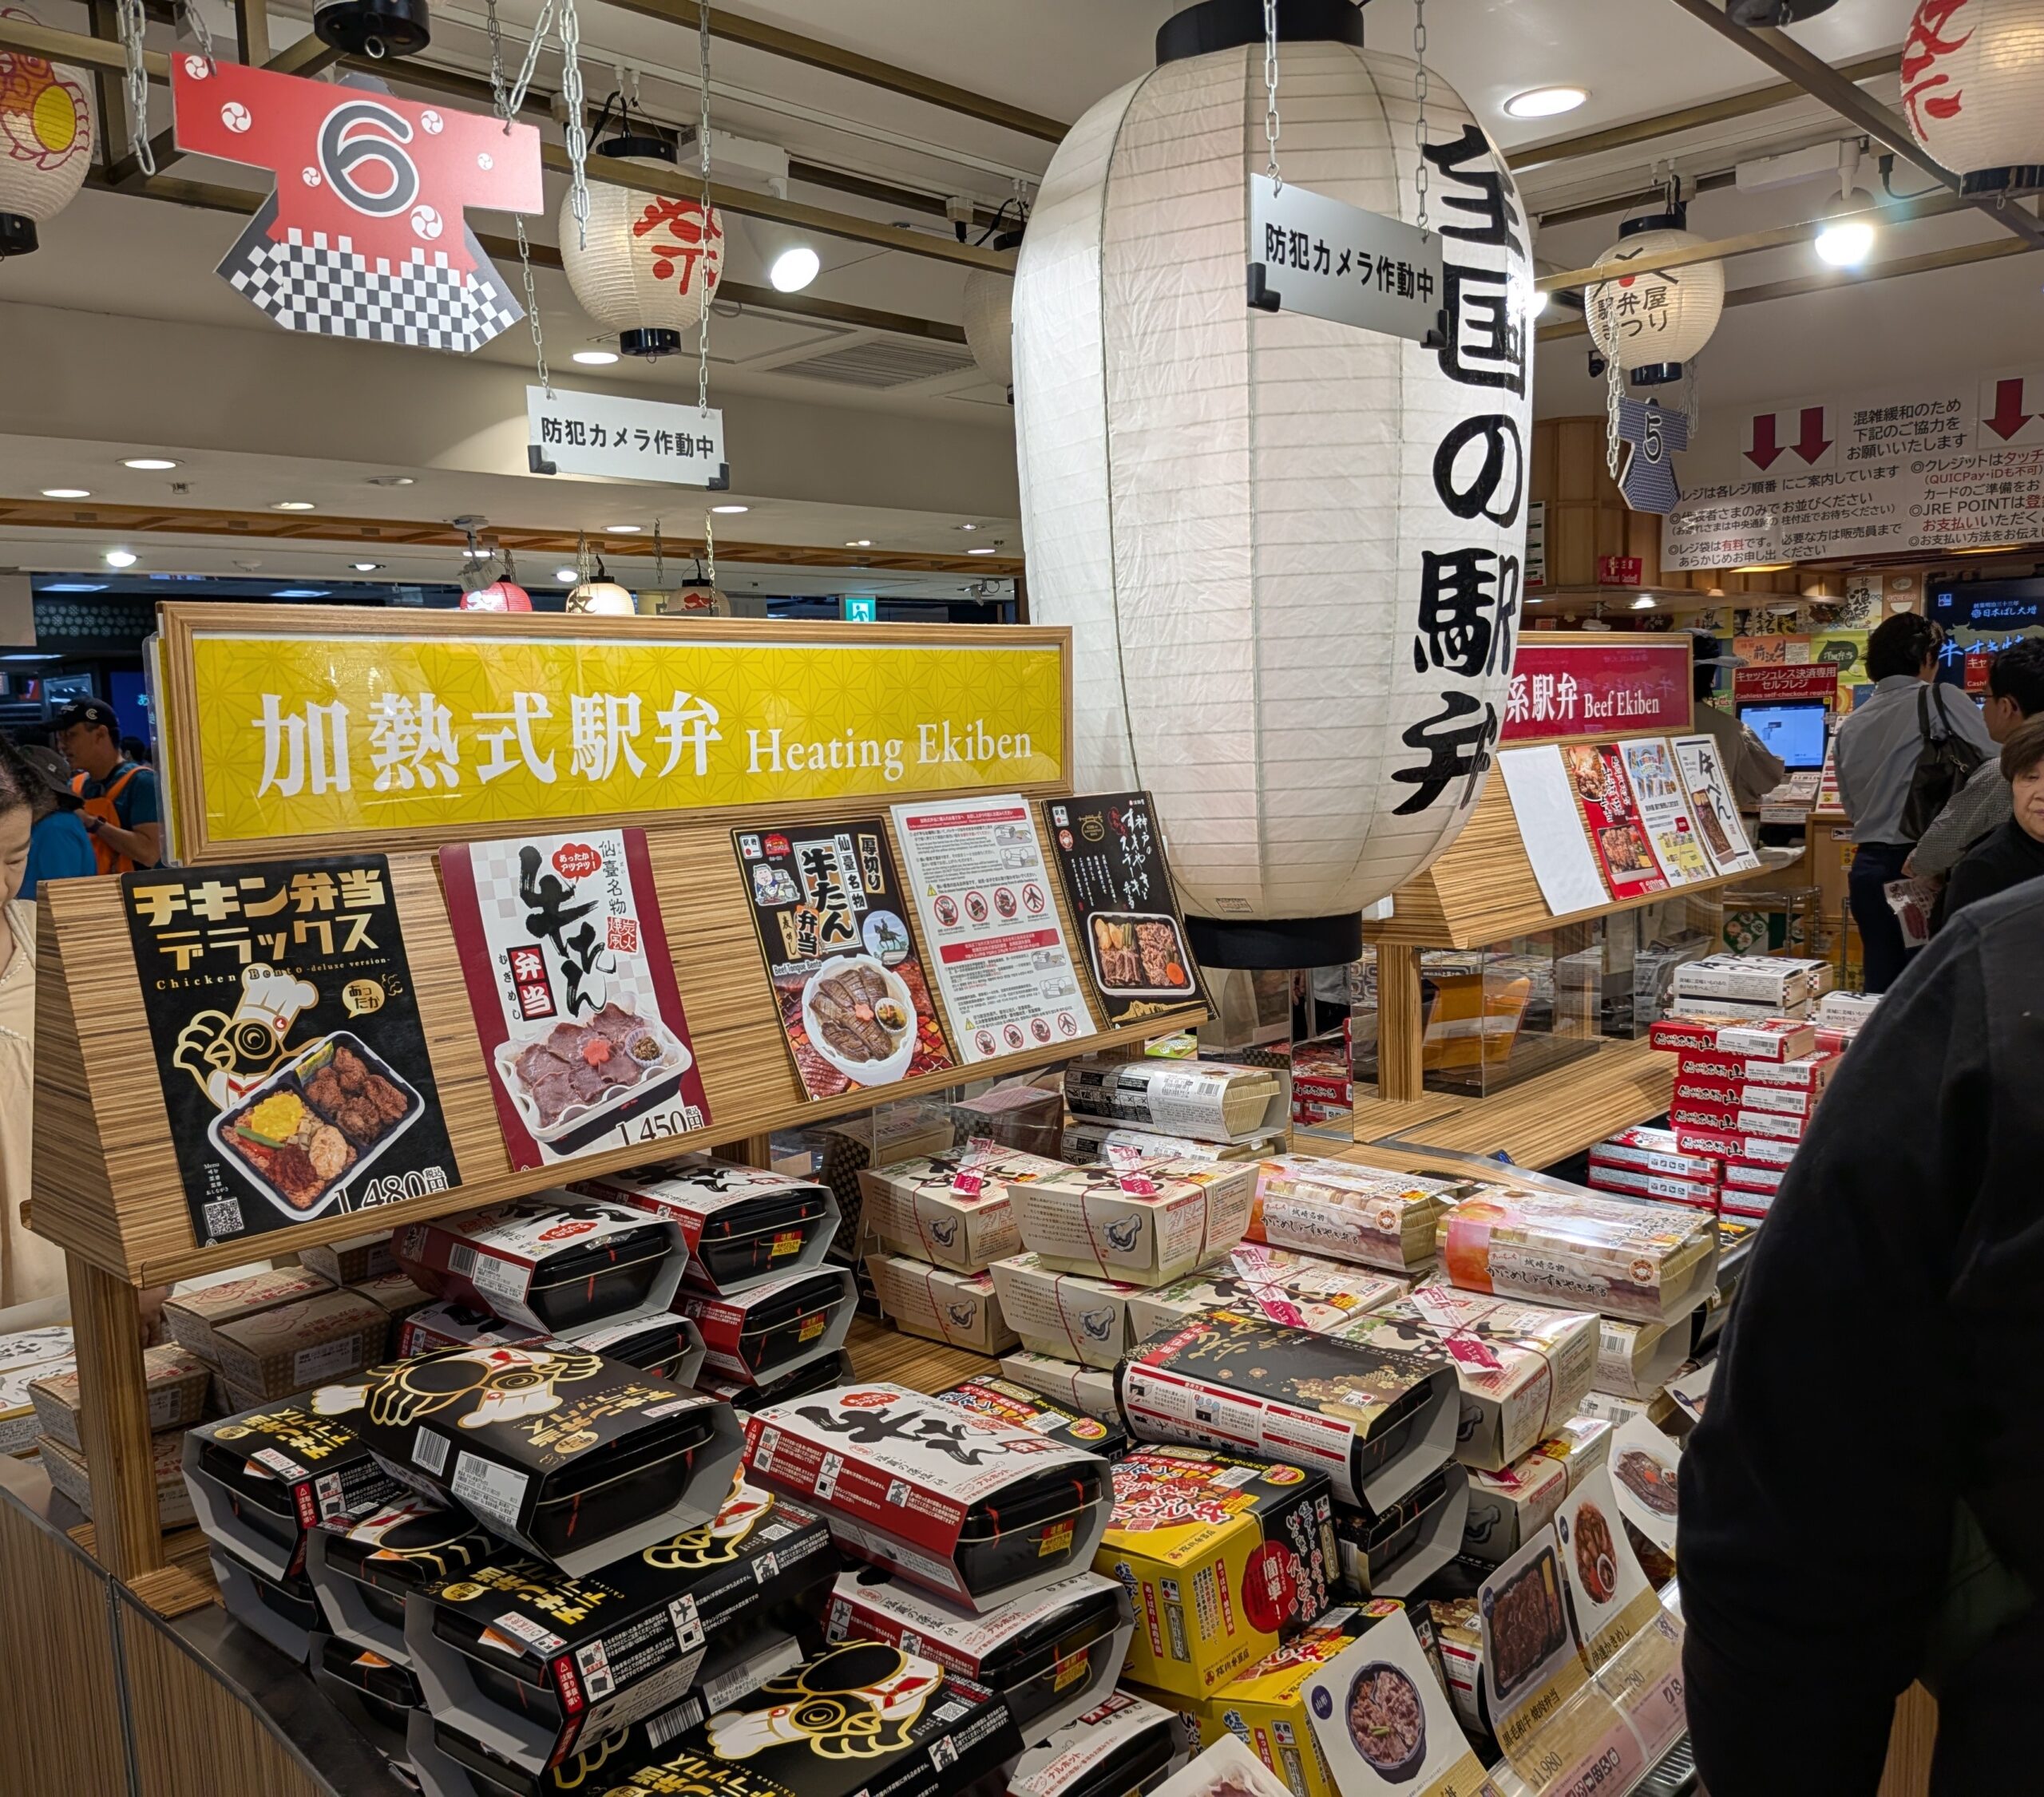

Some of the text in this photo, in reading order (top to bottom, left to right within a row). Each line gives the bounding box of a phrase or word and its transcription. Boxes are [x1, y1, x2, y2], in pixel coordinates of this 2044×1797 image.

[317, 99, 420, 218] 6
[1265, 222, 1435, 304] 防犯カメラ作動中
[1853, 398, 1962, 426] 混雑緩和のため
[1854, 416, 1961, 442] 下記のご協力を
[541, 417, 715, 461] 防犯カメラ作動中
[1643, 411, 1663, 464] 5
[1847, 432, 1968, 460] お願いいたします
[1583, 693, 1614, 718] Beef
[1616, 690, 1661, 716] Ekiben
[1761, 679, 1808, 690] セルフレジ
[252, 691, 1032, 799] 加熱式駅弁 Heating Ekiben
[598, 840, 628, 916] 仙臺名物
[862, 837, 882, 891] 厚切り
[133, 869, 386, 927] チキン弁当
[801, 848, 855, 943] 牛たん
[156, 913, 381, 972] デラックス
[797, 909, 818, 956] 弁当
[156, 972, 238, 991] Chicken
[248, 965, 303, 981] Bento
[498, 952, 522, 1021] むぎめし
[514, 951, 552, 1017] 弁当
[774, 964, 788, 975] Beef
[616, 1111, 703, 1145] 1450円
[334, 1170, 448, 1215] 1480円
[1289, 1411, 1301, 1419] How
[1311, 1416, 1323, 1425] Use
[1288, 1439, 1313, 1451] Cautions
[1502, 1688, 1560, 1749] 黒毛和牛 焼肉弁当
[1530, 1751, 1563, 1789] ¥1,980
